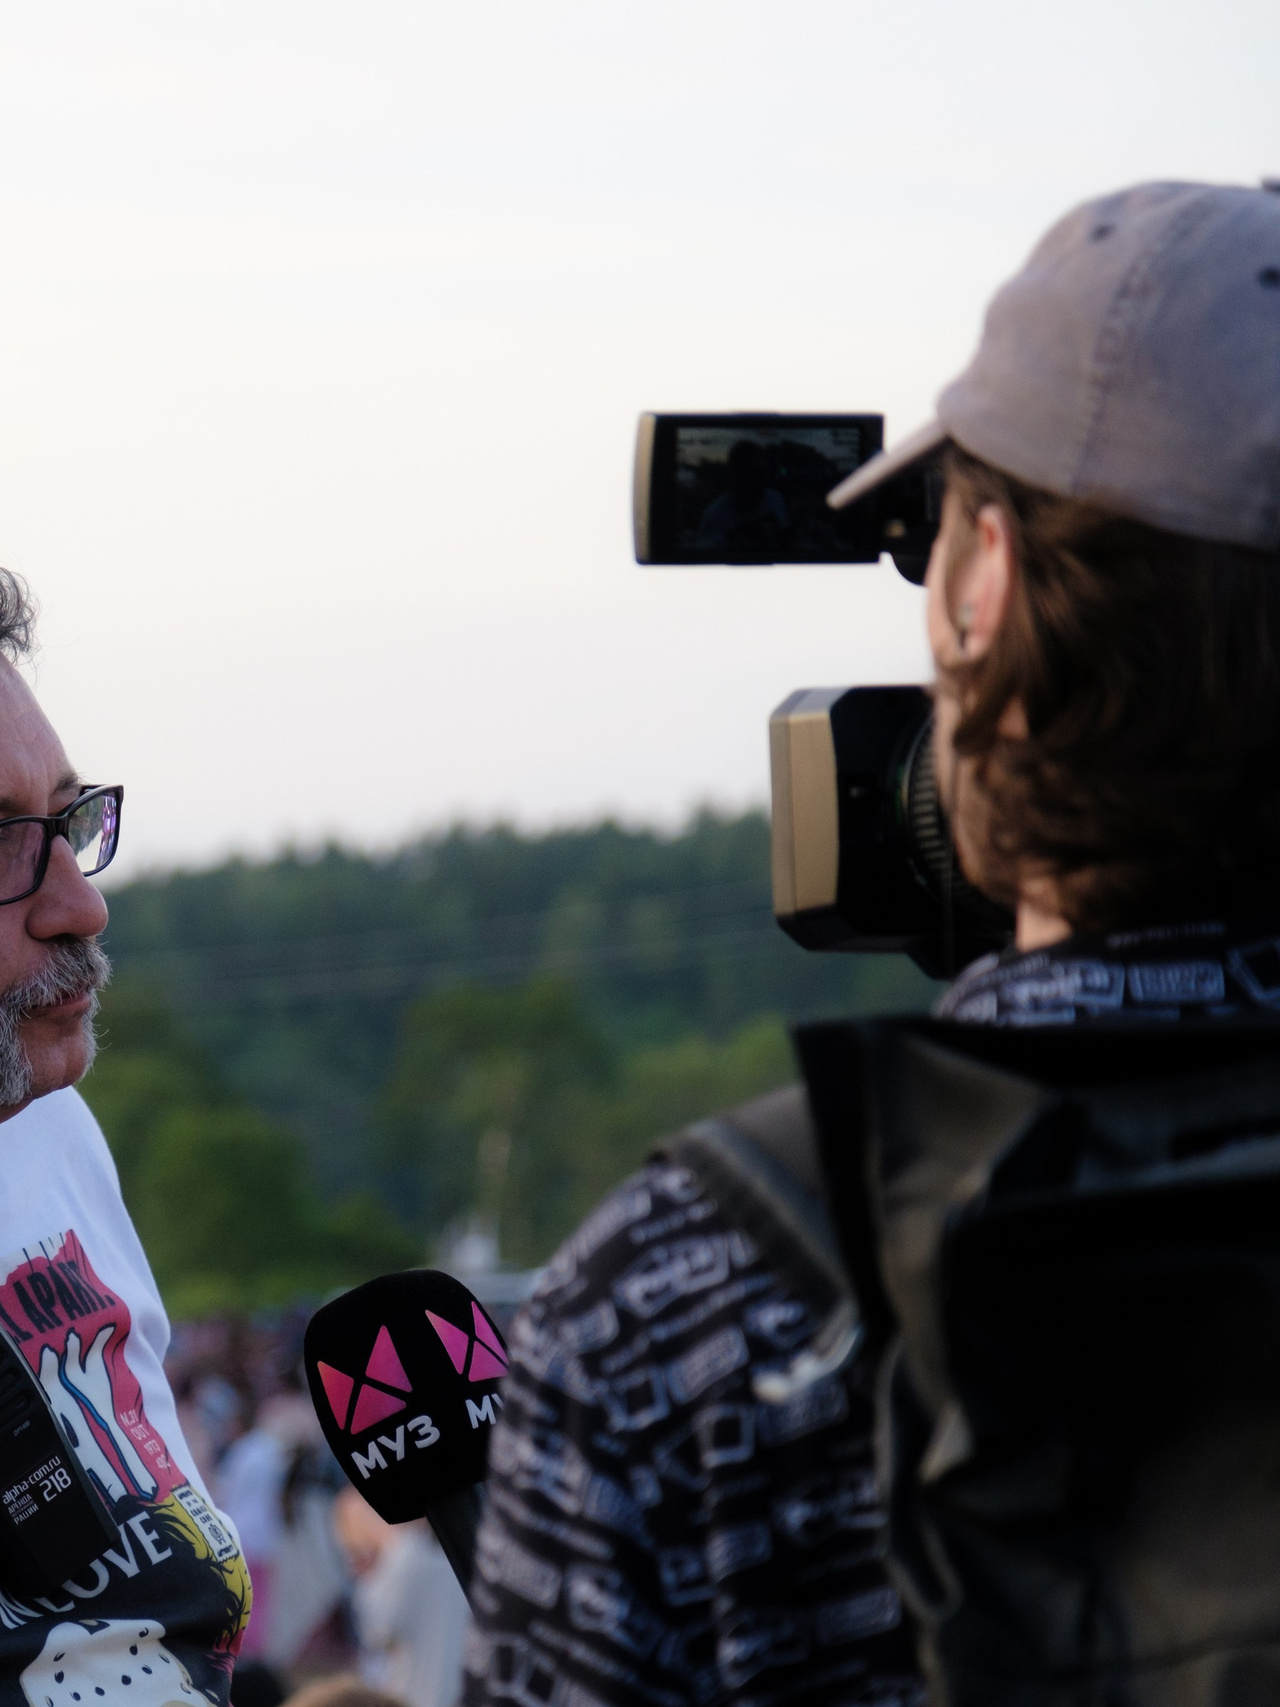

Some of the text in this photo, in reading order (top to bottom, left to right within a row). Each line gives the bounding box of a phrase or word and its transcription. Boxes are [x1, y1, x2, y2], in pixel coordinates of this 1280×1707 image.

[351, 1415, 440, 1480] МУЗ
[1, 1455, 62, 1505] alpha-com.ru
[39, 1467, 72, 1502] 218
[7, 1493, 33, 1515] АРЕНДА
